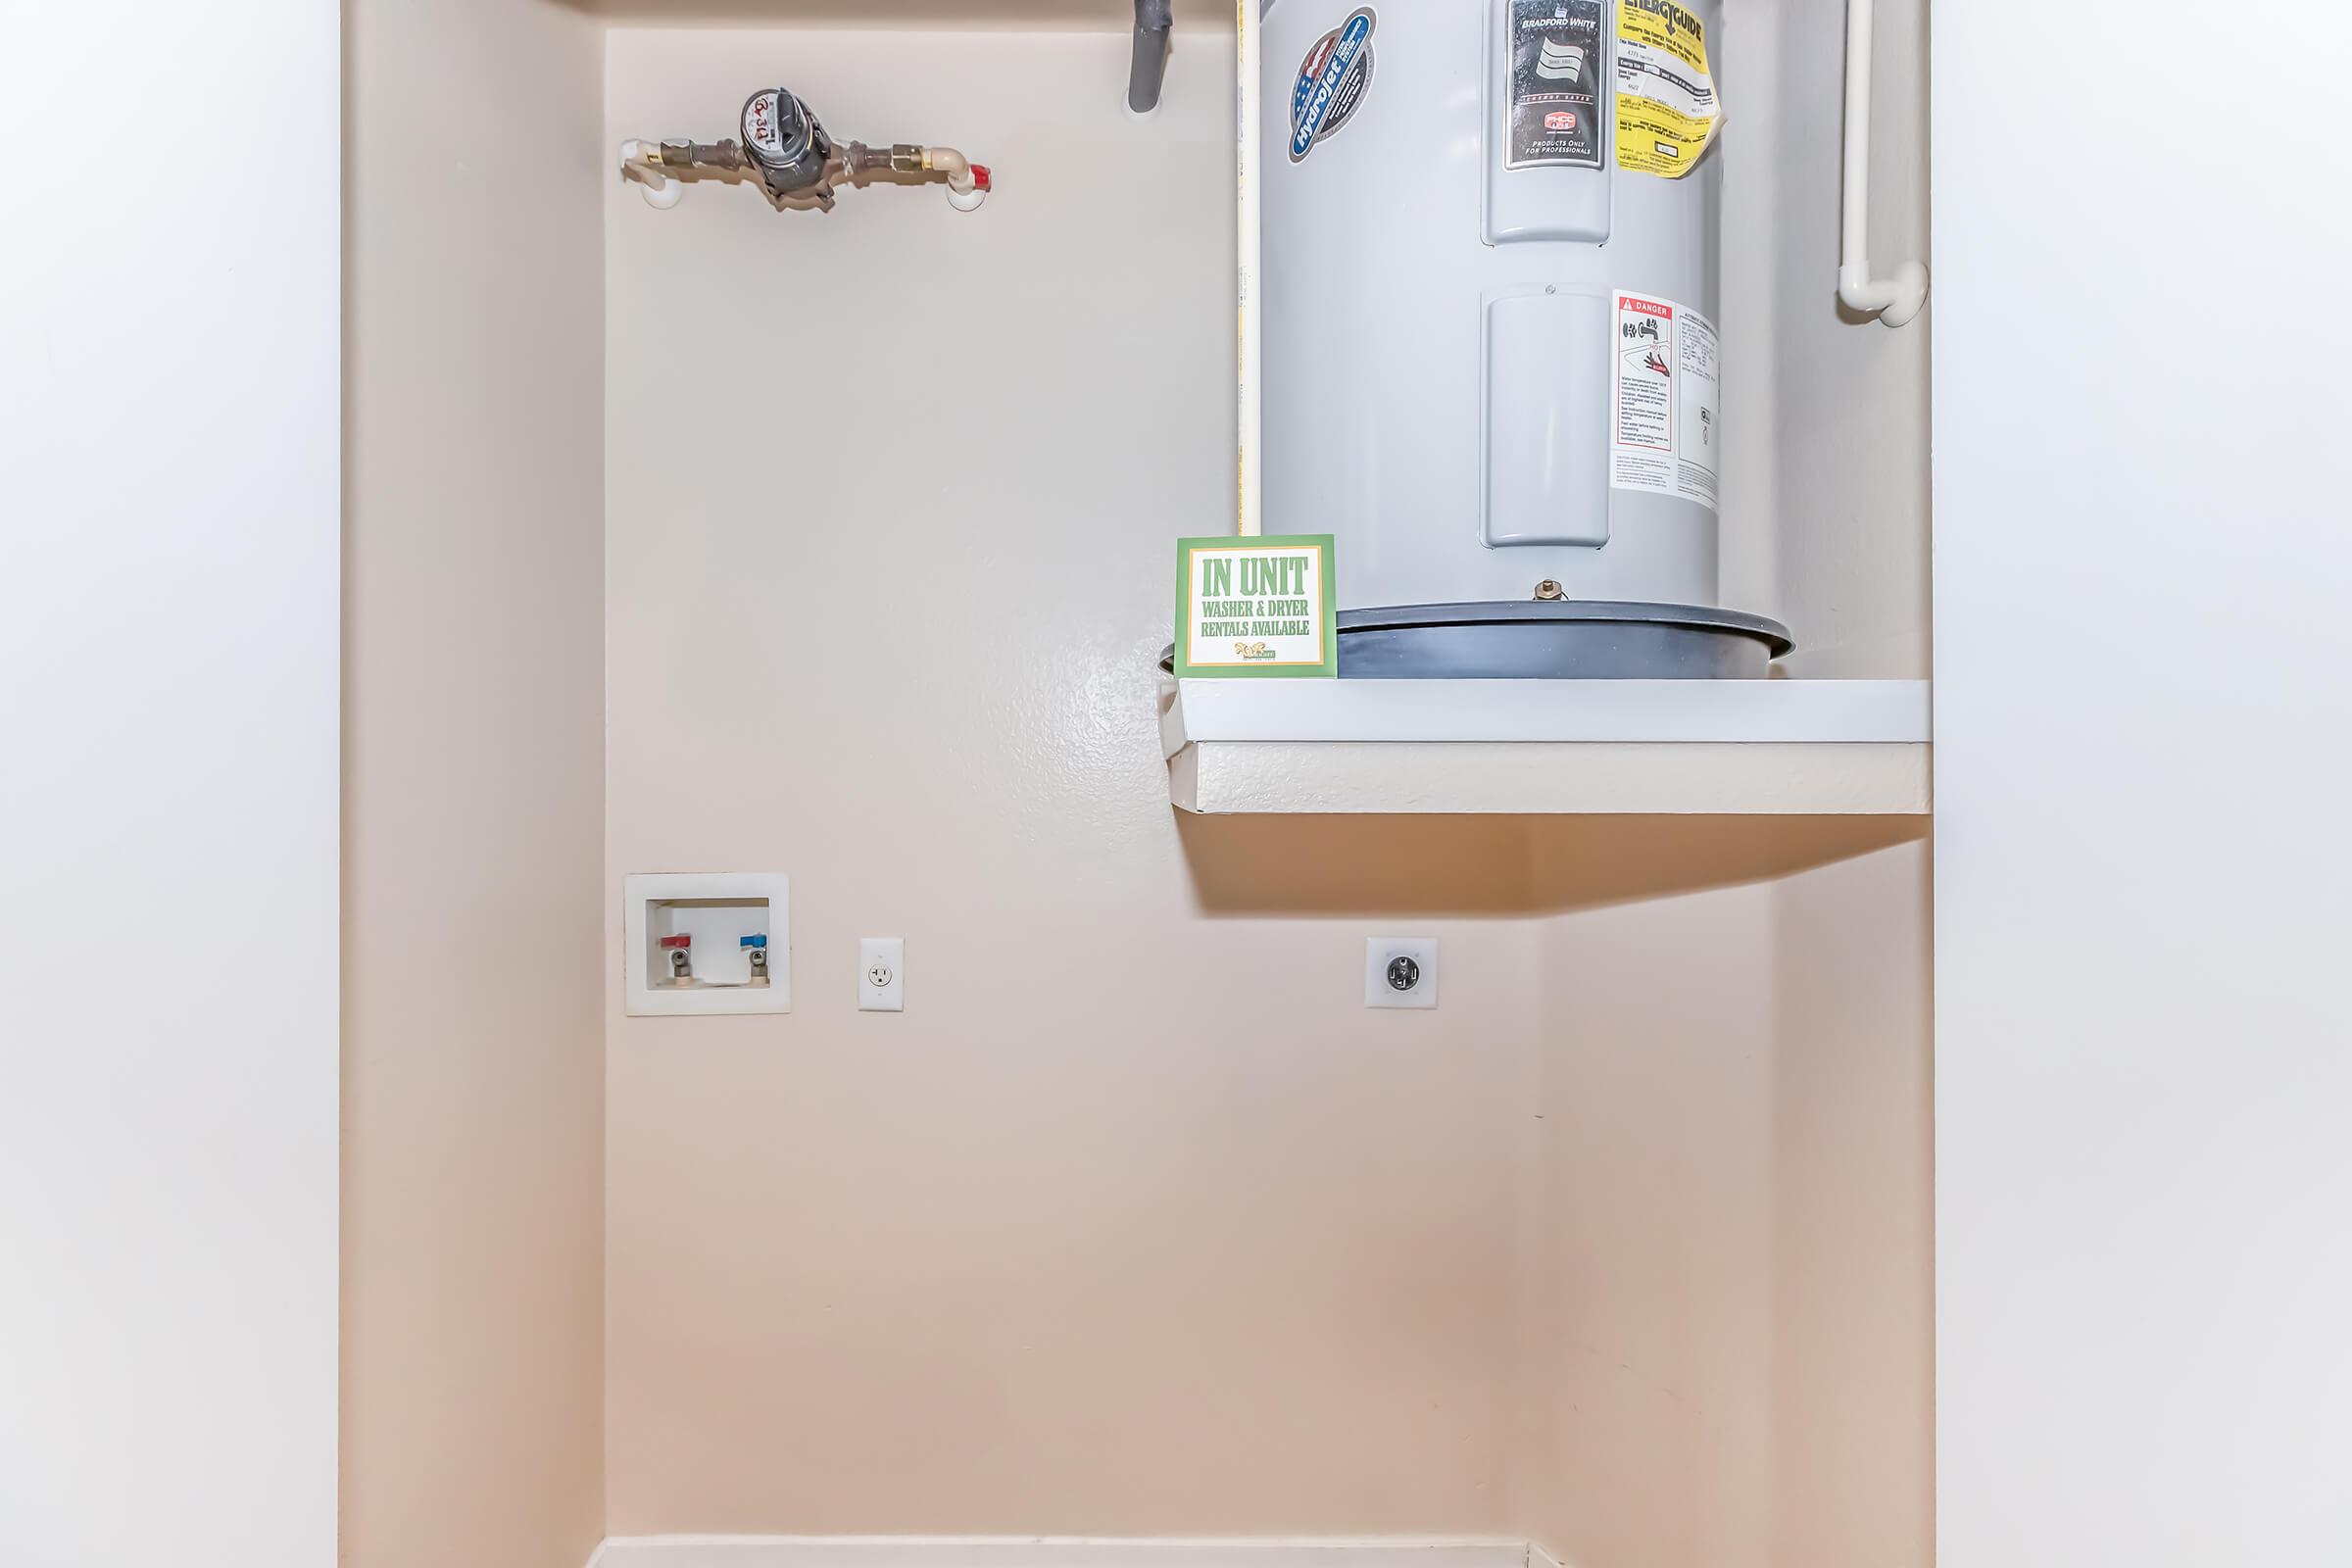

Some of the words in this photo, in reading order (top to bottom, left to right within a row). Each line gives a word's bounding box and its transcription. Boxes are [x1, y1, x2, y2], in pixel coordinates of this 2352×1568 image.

[1522, 18, 1568, 29] BRADFORD
[1569, 18, 1596, 29] WHITE
[1297, 57, 1342, 148] Hydrojet
[1568, 139, 1586, 148] ONLY
[1541, 146, 1592, 155] PROFESSIONALS
[1636, 302, 1668, 315] DANGER
[1649, 343, 1662, 352] HOT
[1201, 559, 1232, 597] IN
[1240, 557, 1308, 597] UNIT
[1201, 600, 1254, 617] WASHER
[1256, 601, 1265, 617] &
[1268, 599, 1309, 616] DRYER
[1200, 621, 1250, 637] RENTALS
[1250, 619, 1310, 636] AVAILABLE
